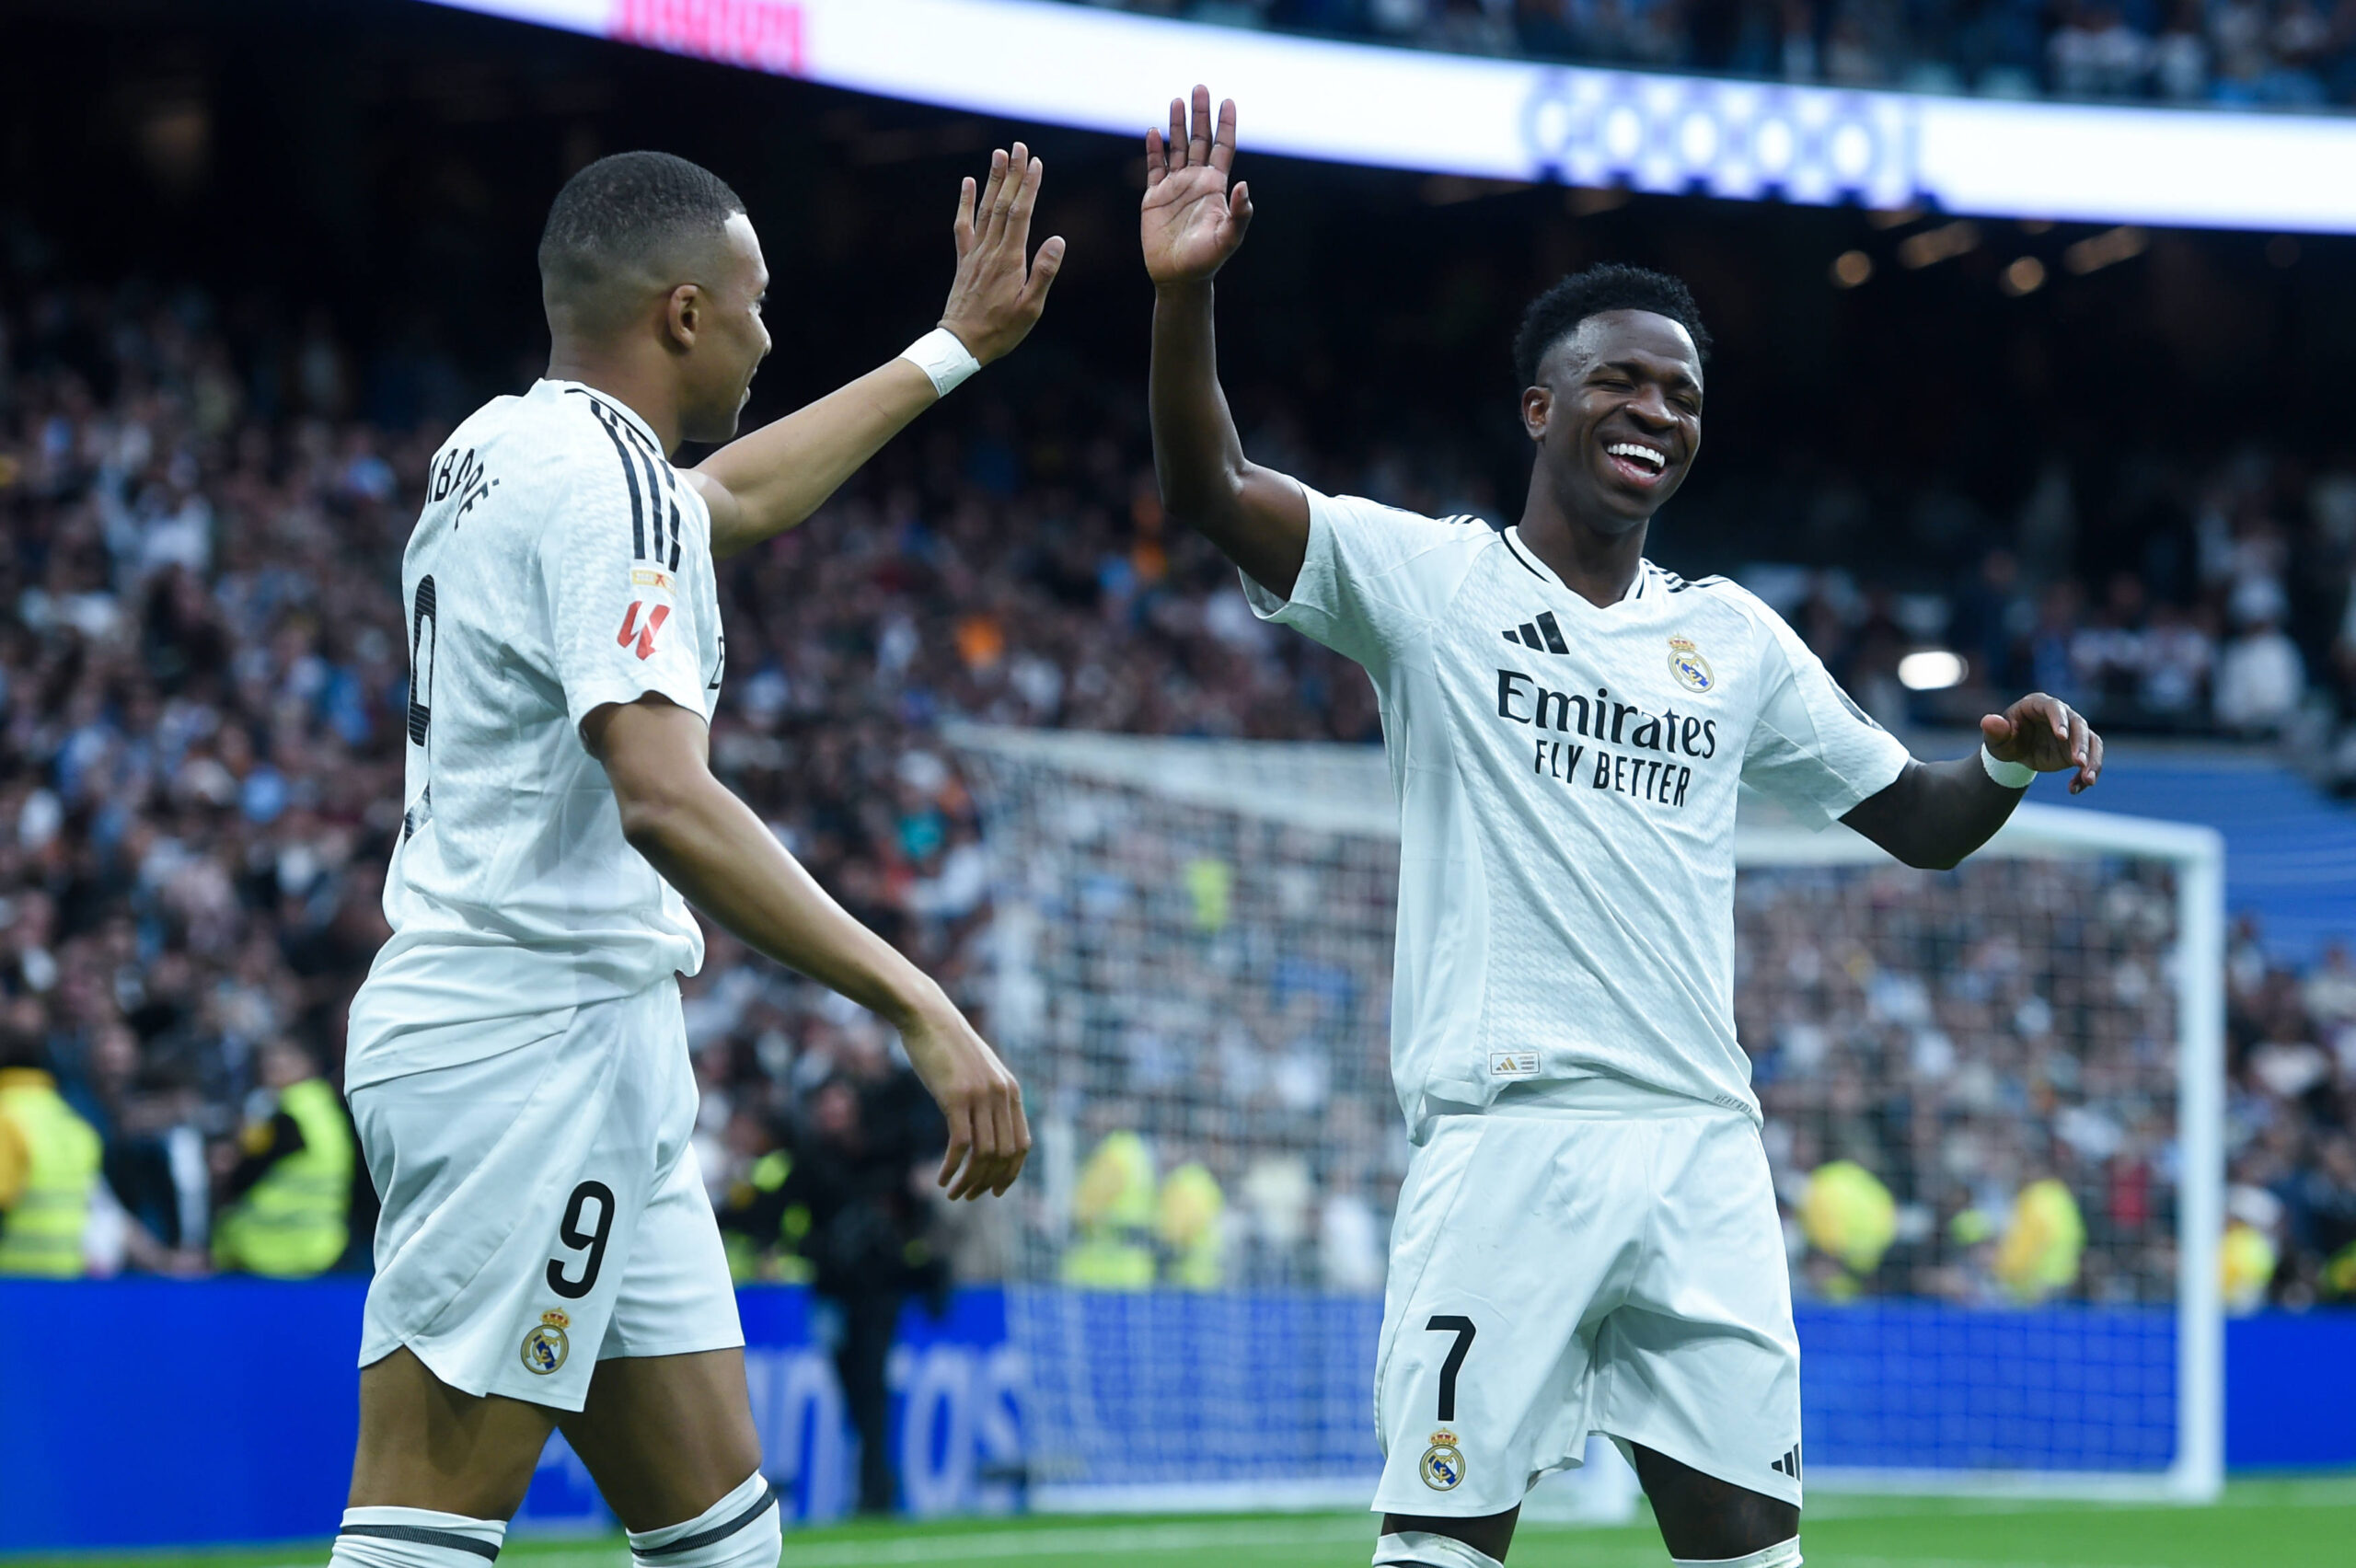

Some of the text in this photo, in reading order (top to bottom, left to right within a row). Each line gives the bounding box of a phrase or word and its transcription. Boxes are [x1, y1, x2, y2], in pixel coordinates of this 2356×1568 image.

[1496, 669, 1717, 759] Emirates
[1534, 739, 1691, 808] FLY BETTER
[546, 1180, 616, 1299] 9
[1425, 1315, 1476, 1422] 7
